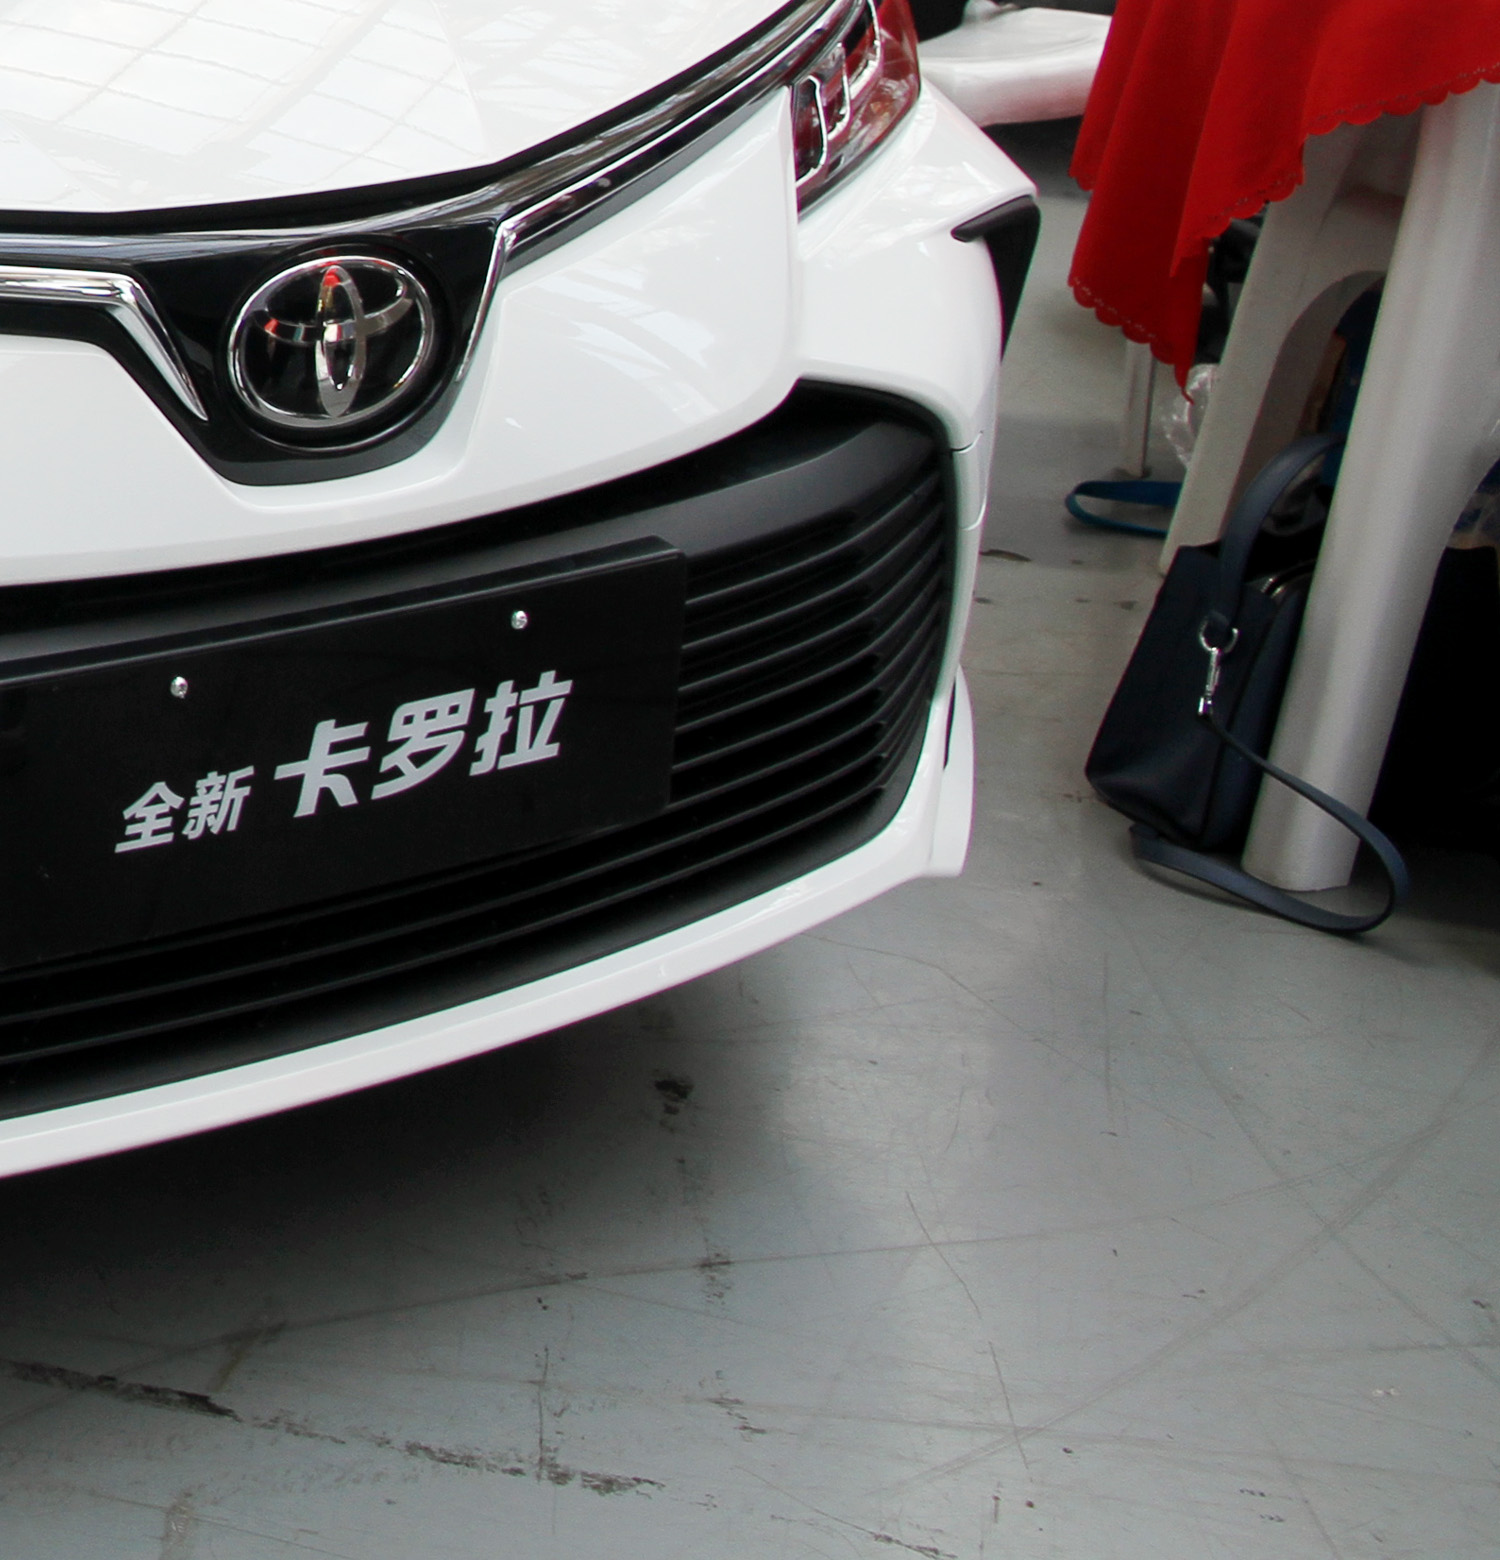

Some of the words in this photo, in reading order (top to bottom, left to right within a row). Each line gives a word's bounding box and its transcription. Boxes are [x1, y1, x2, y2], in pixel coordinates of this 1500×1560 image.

[114, 765, 257, 853] 全新
[273, 669, 573, 818] 卡罗拉
